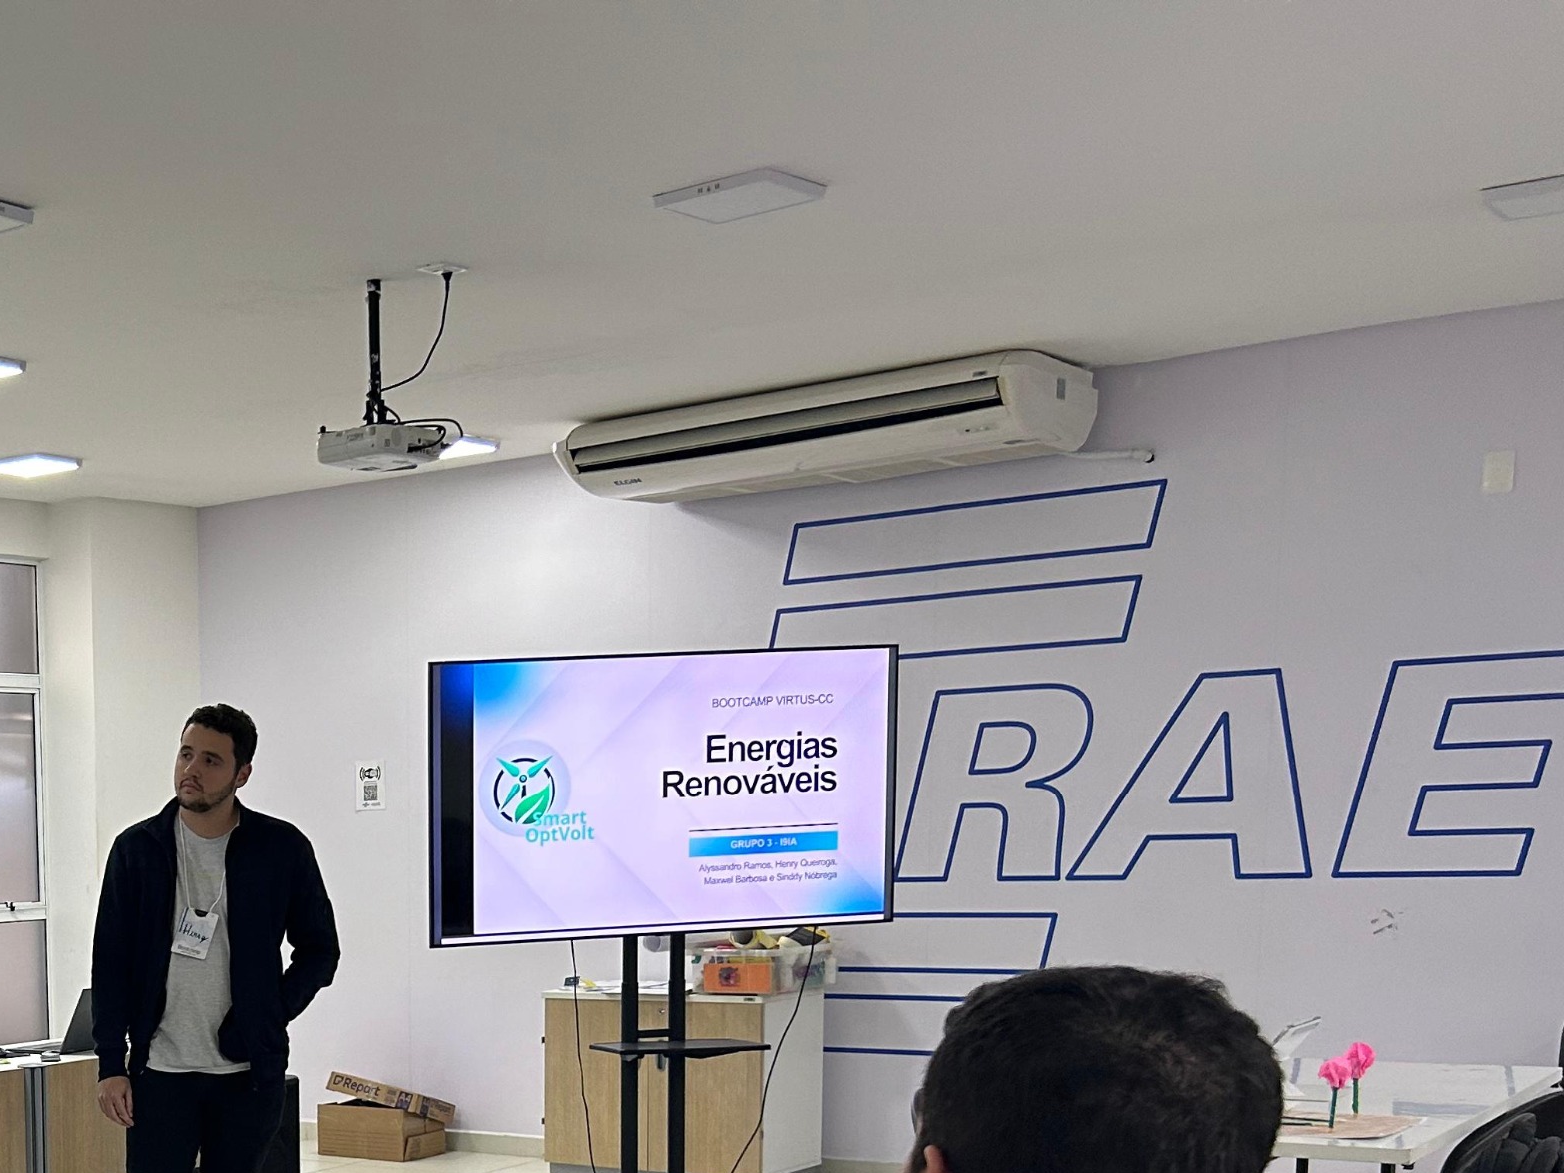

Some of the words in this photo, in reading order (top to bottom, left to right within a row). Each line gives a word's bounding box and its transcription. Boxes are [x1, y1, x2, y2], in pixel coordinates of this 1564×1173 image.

[711, 695, 774, 709] BOOTCAMP
[776, 693, 834, 706] VIRTUS-CC
[706, 731, 838, 768] Energias
[662, 764, 838, 799] Renováveis
[532, 811, 587, 826] Smart
[525, 825, 595, 847] OptVolt
[730, 838, 765, 850] GRUPO
[767, 837, 773, 847] 3
[775, 859, 798, 870] Henry
[735, 874, 768, 884] Barbosa
[342, 1077, 381, 1097] Report
